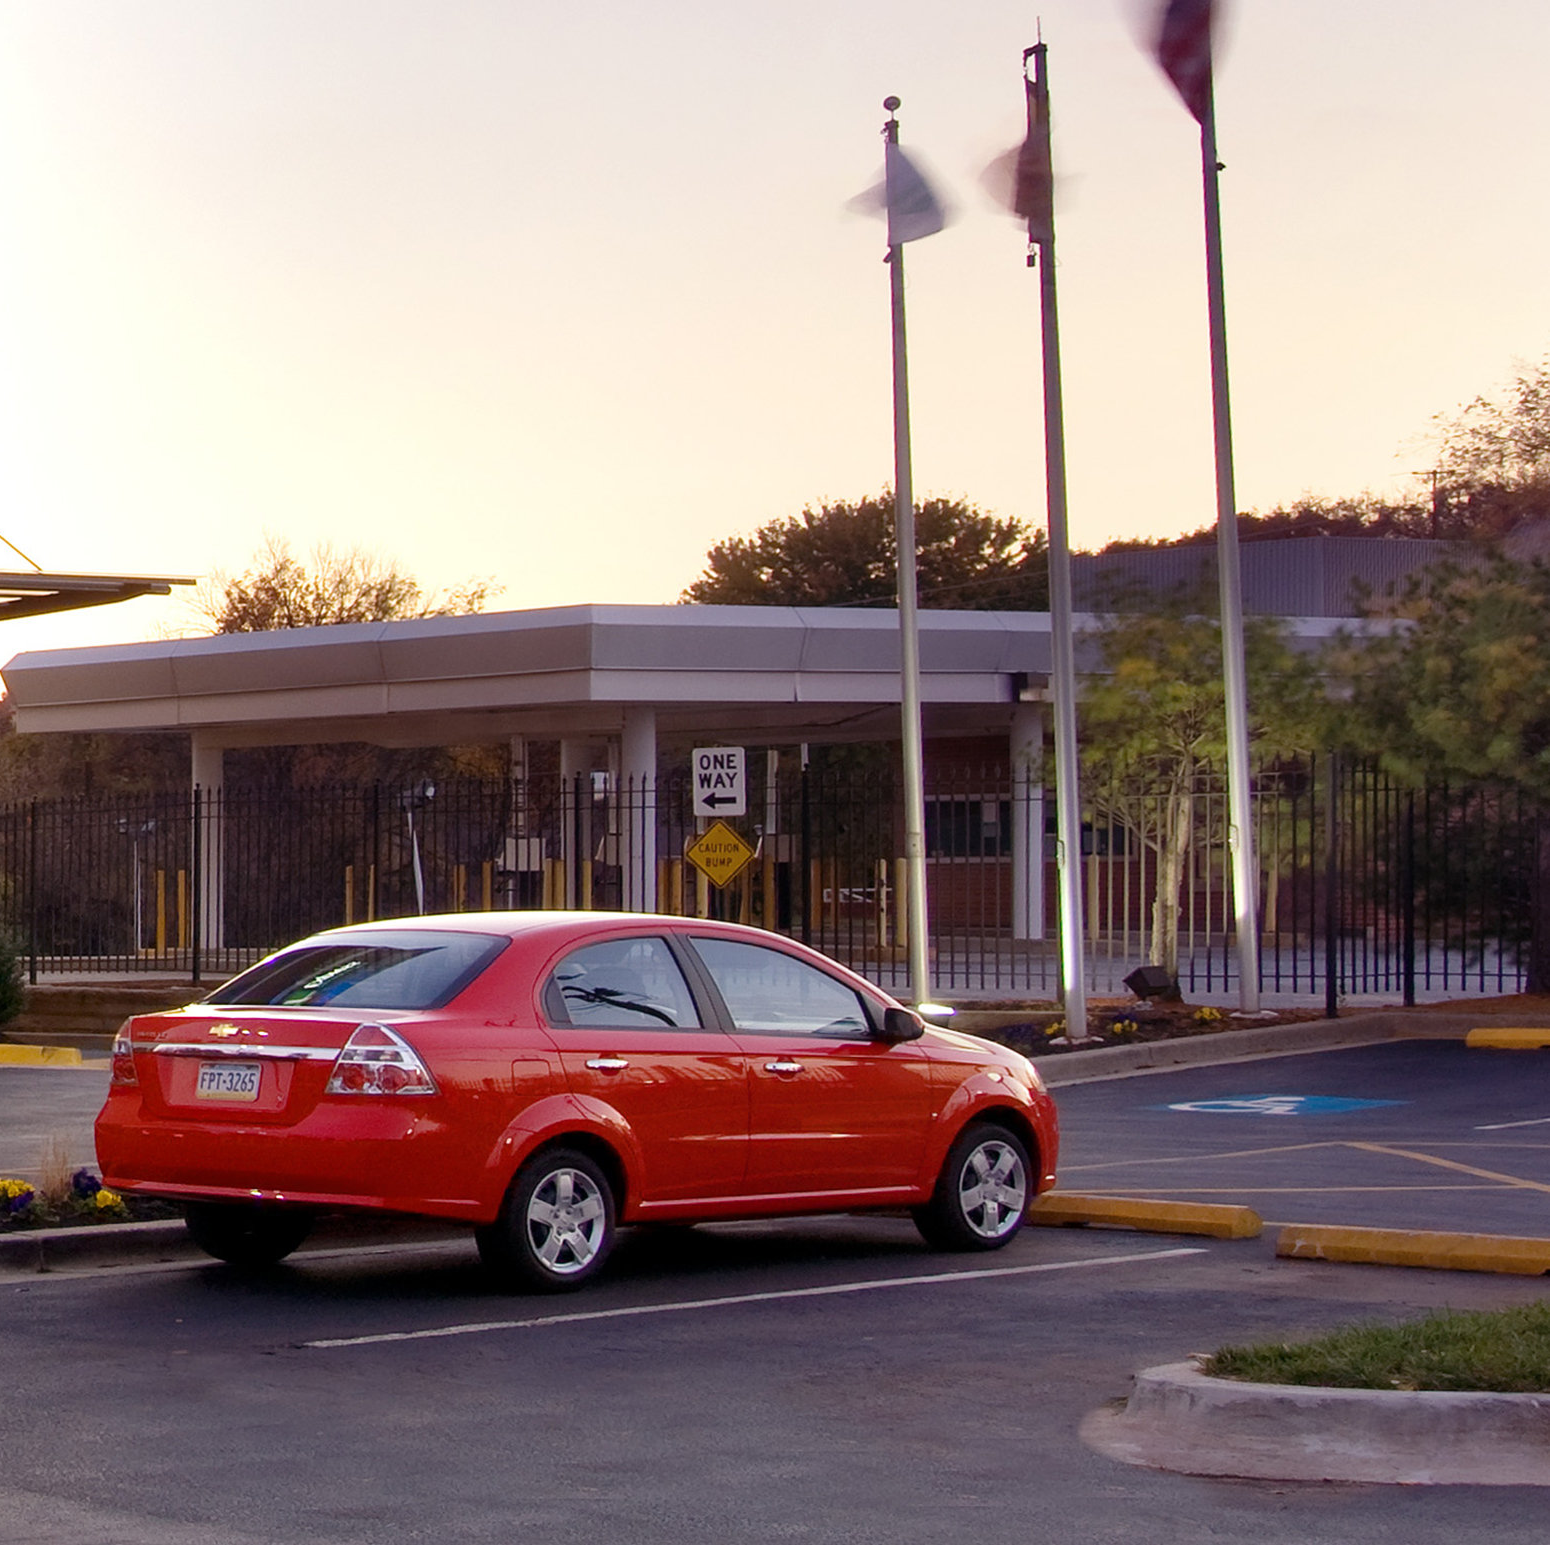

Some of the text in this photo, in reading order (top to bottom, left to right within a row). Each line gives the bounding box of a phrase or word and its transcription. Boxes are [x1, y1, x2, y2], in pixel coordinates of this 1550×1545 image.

[699, 753, 738, 771] ONE
[698, 772, 738, 789] WAY
[698, 842, 740, 854] CAUTION
[705, 857, 733, 868] BUMP
